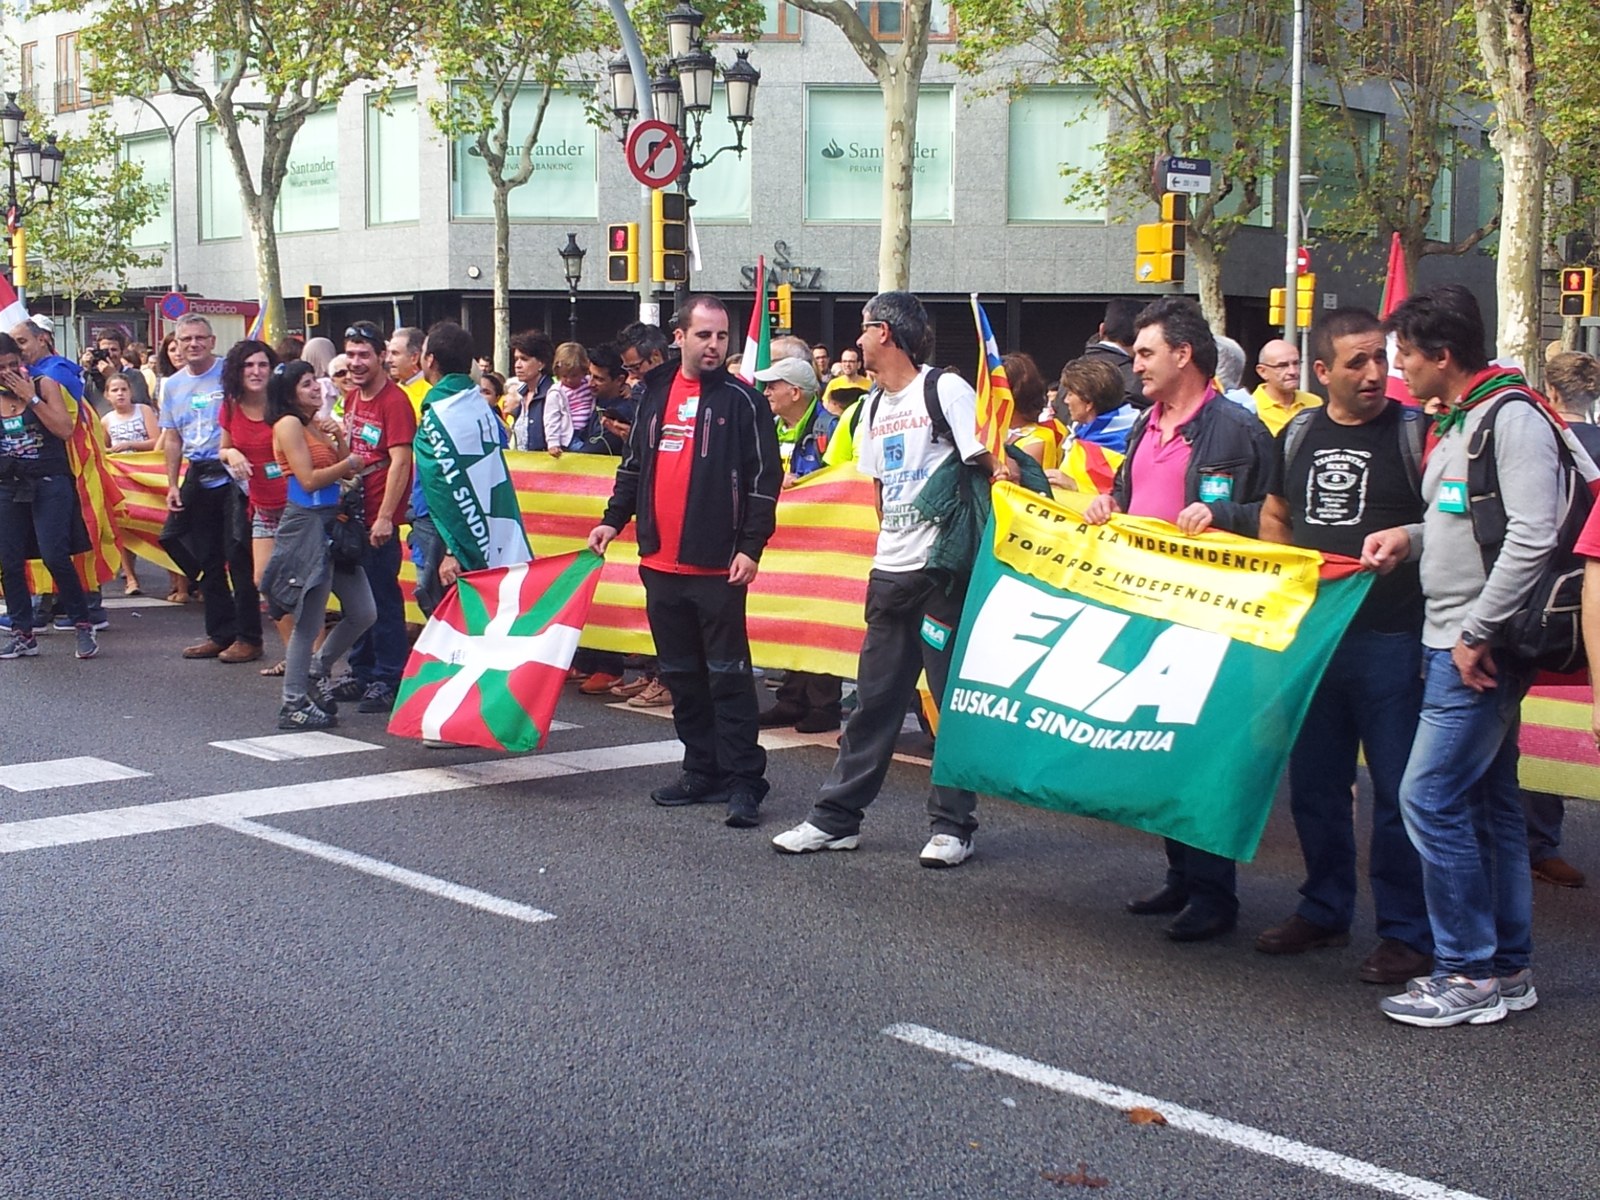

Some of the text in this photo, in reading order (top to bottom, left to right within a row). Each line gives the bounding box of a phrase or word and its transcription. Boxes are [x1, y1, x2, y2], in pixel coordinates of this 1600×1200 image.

[506, 139, 585, 156] anander
[849, 142, 938, 159] Sander
[290, 156, 335, 175] Santander
[849, 165, 883, 173] PRIVATE
[740, 265, 821, 289] SAEZ
[190, 302, 237, 315] Periódico
[4, 420, 22, 431] ELA
[1201, 480, 1231, 495] ELA
[1025, 503, 1282, 576] CAP A LA INDEPENDÈNCIA
[1007, 533, 1106, 576] TOWARDS
[1113, 572, 1266, 619] INDEPENDENCE
[922, 620, 945, 644] ELA
[958, 574, 1232, 726] ELA
[949, 687, 1177, 752] EUSKAL SINDIKATUA
